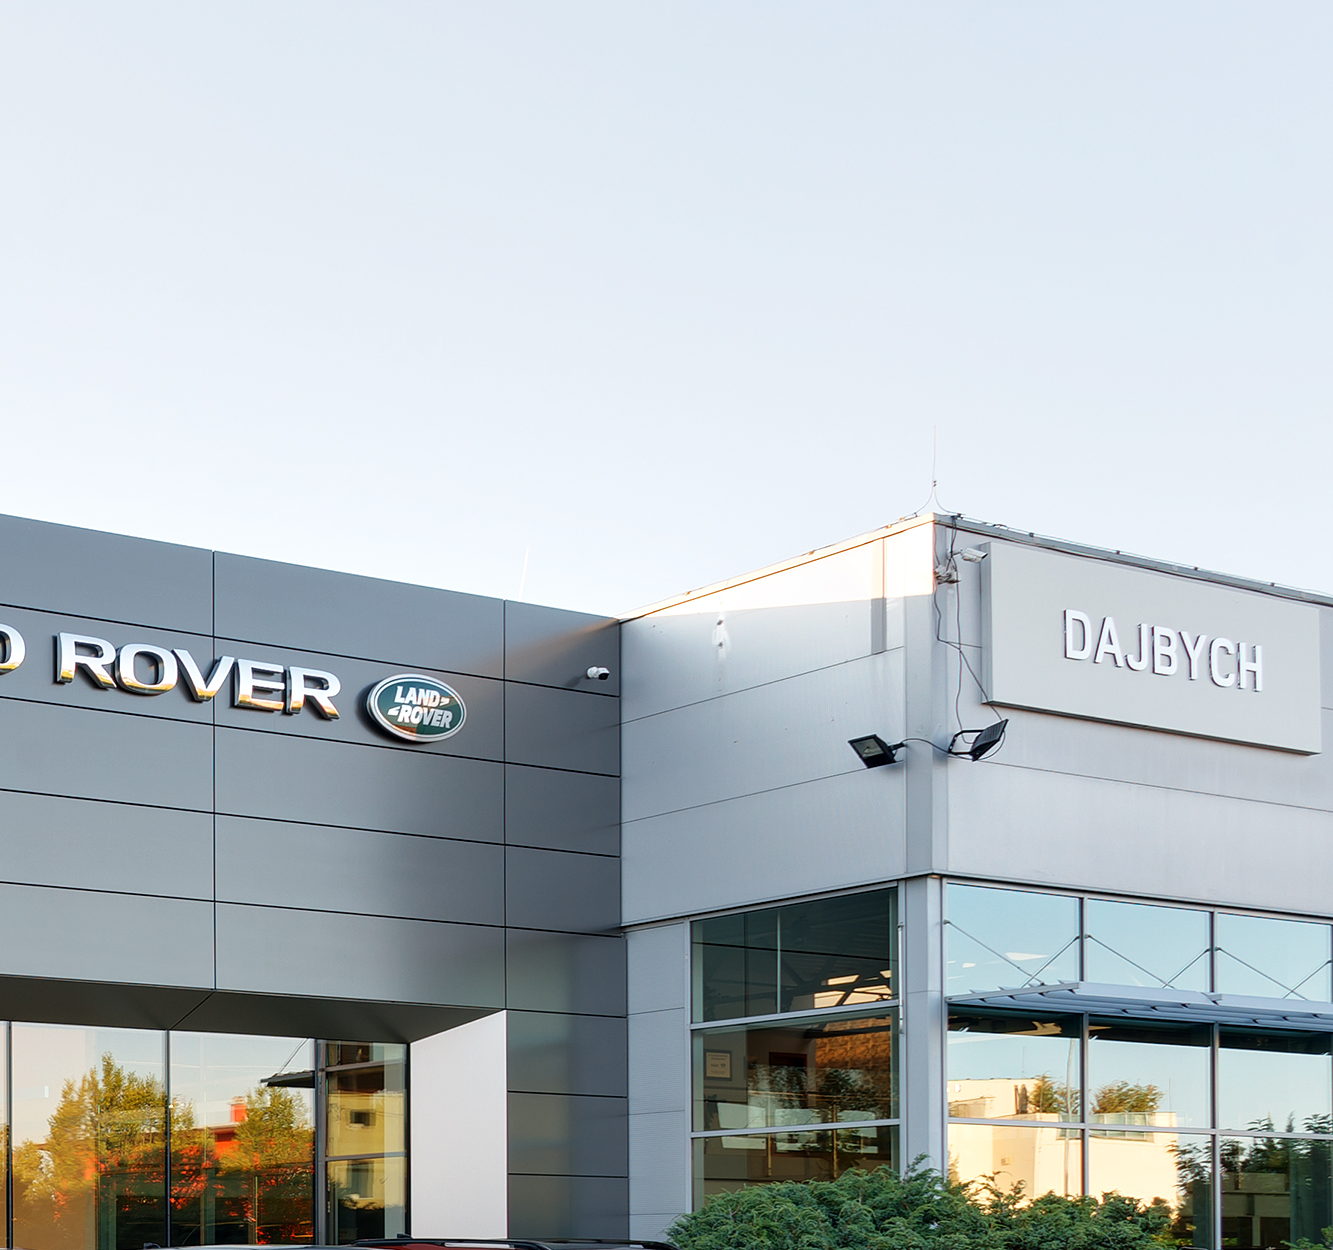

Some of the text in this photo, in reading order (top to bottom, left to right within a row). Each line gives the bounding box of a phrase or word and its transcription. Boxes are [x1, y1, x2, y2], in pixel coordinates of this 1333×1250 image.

[57, 632, 341, 719] ROVER
[1064, 608, 1263, 692] DAJBYCH
[394, 686, 440, 707] LAND
[397, 705, 453, 728] ROVER
